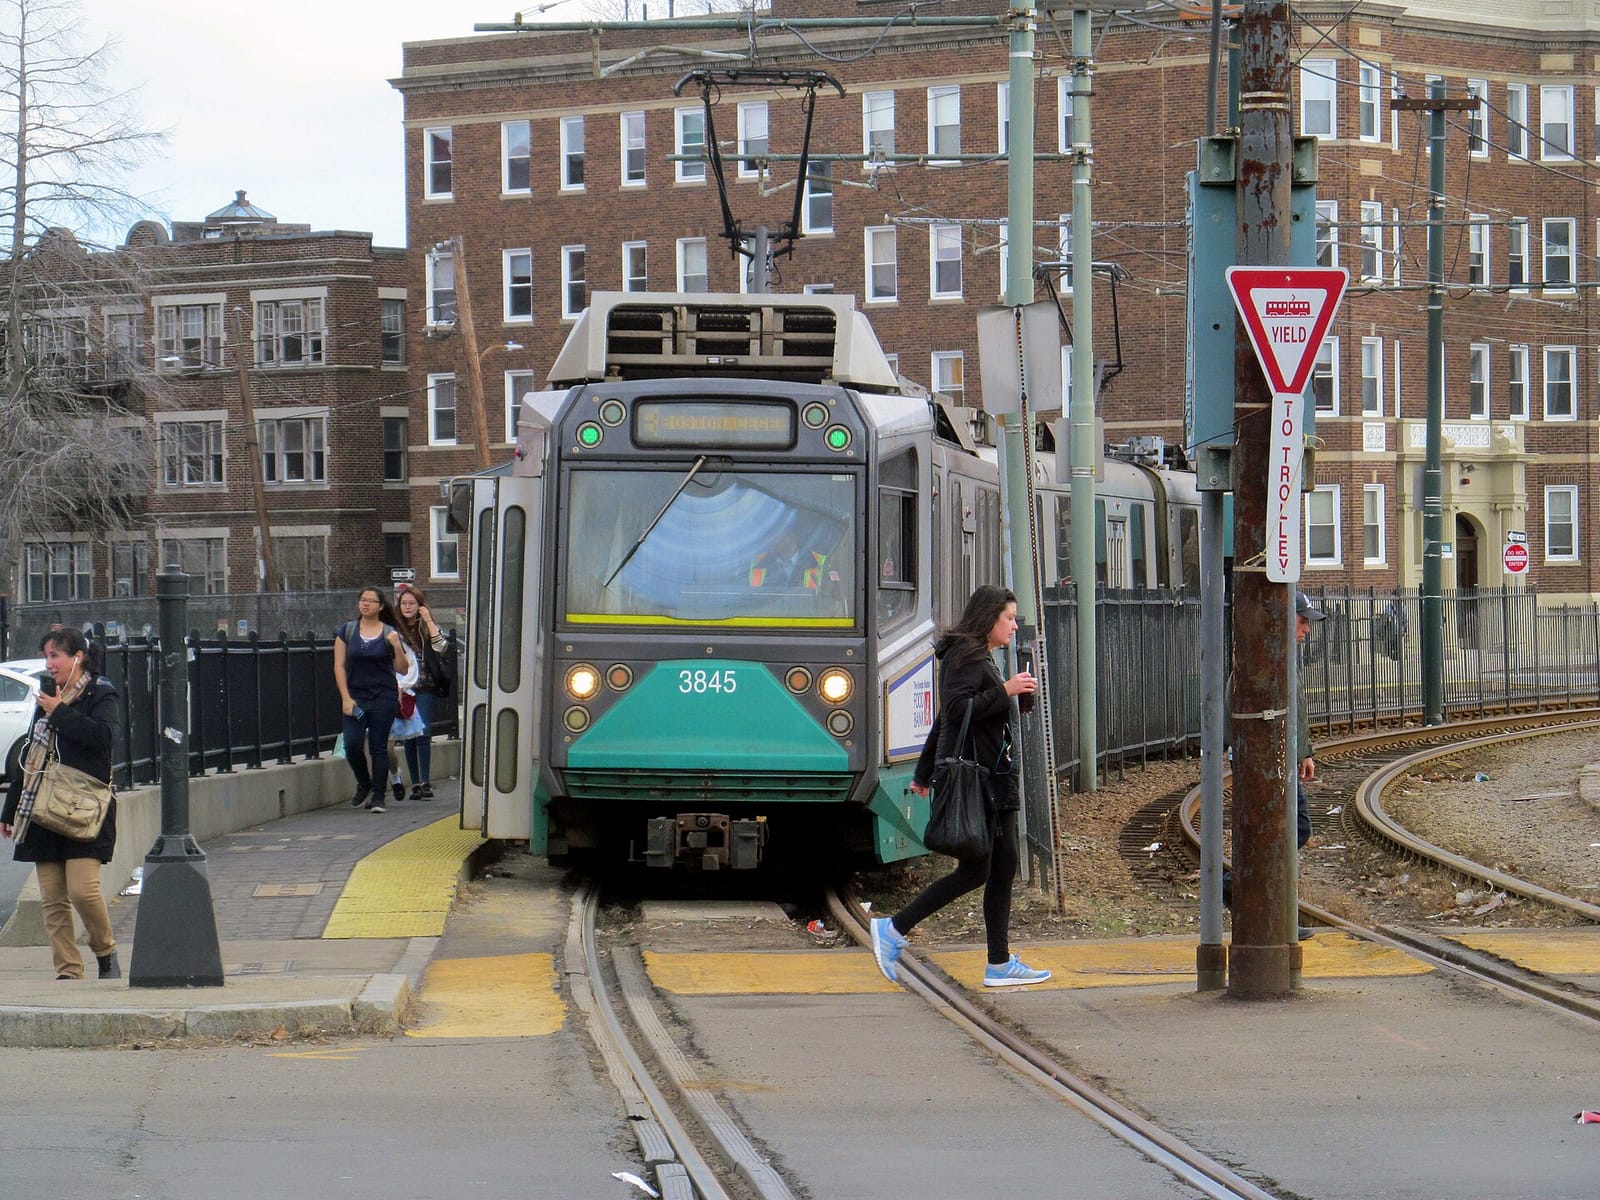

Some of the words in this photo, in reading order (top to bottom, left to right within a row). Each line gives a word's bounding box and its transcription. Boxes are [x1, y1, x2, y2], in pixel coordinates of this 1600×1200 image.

[1271, 326, 1307, 343] YIELD
[1281, 400, 1293, 437] TO
[1278, 447, 1291, 576] TROLLEY
[679, 670, 737, 693] 3845
